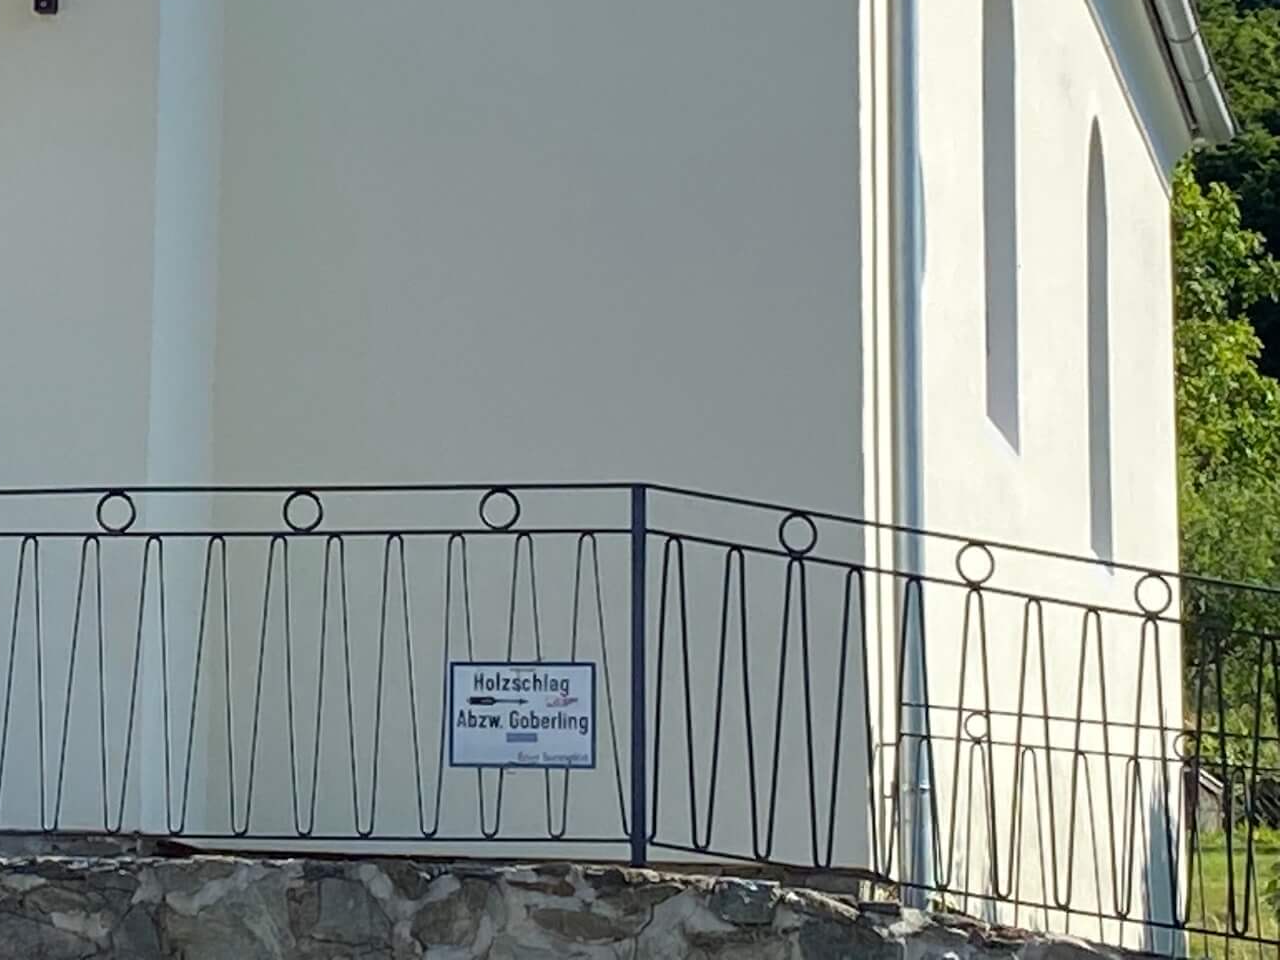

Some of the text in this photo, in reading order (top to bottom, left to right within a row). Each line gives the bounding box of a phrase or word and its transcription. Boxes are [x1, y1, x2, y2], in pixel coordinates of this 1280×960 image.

[473, 673, 570, 696] Holzschlag
[457, 710, 589, 735] Abzw. Goberling
